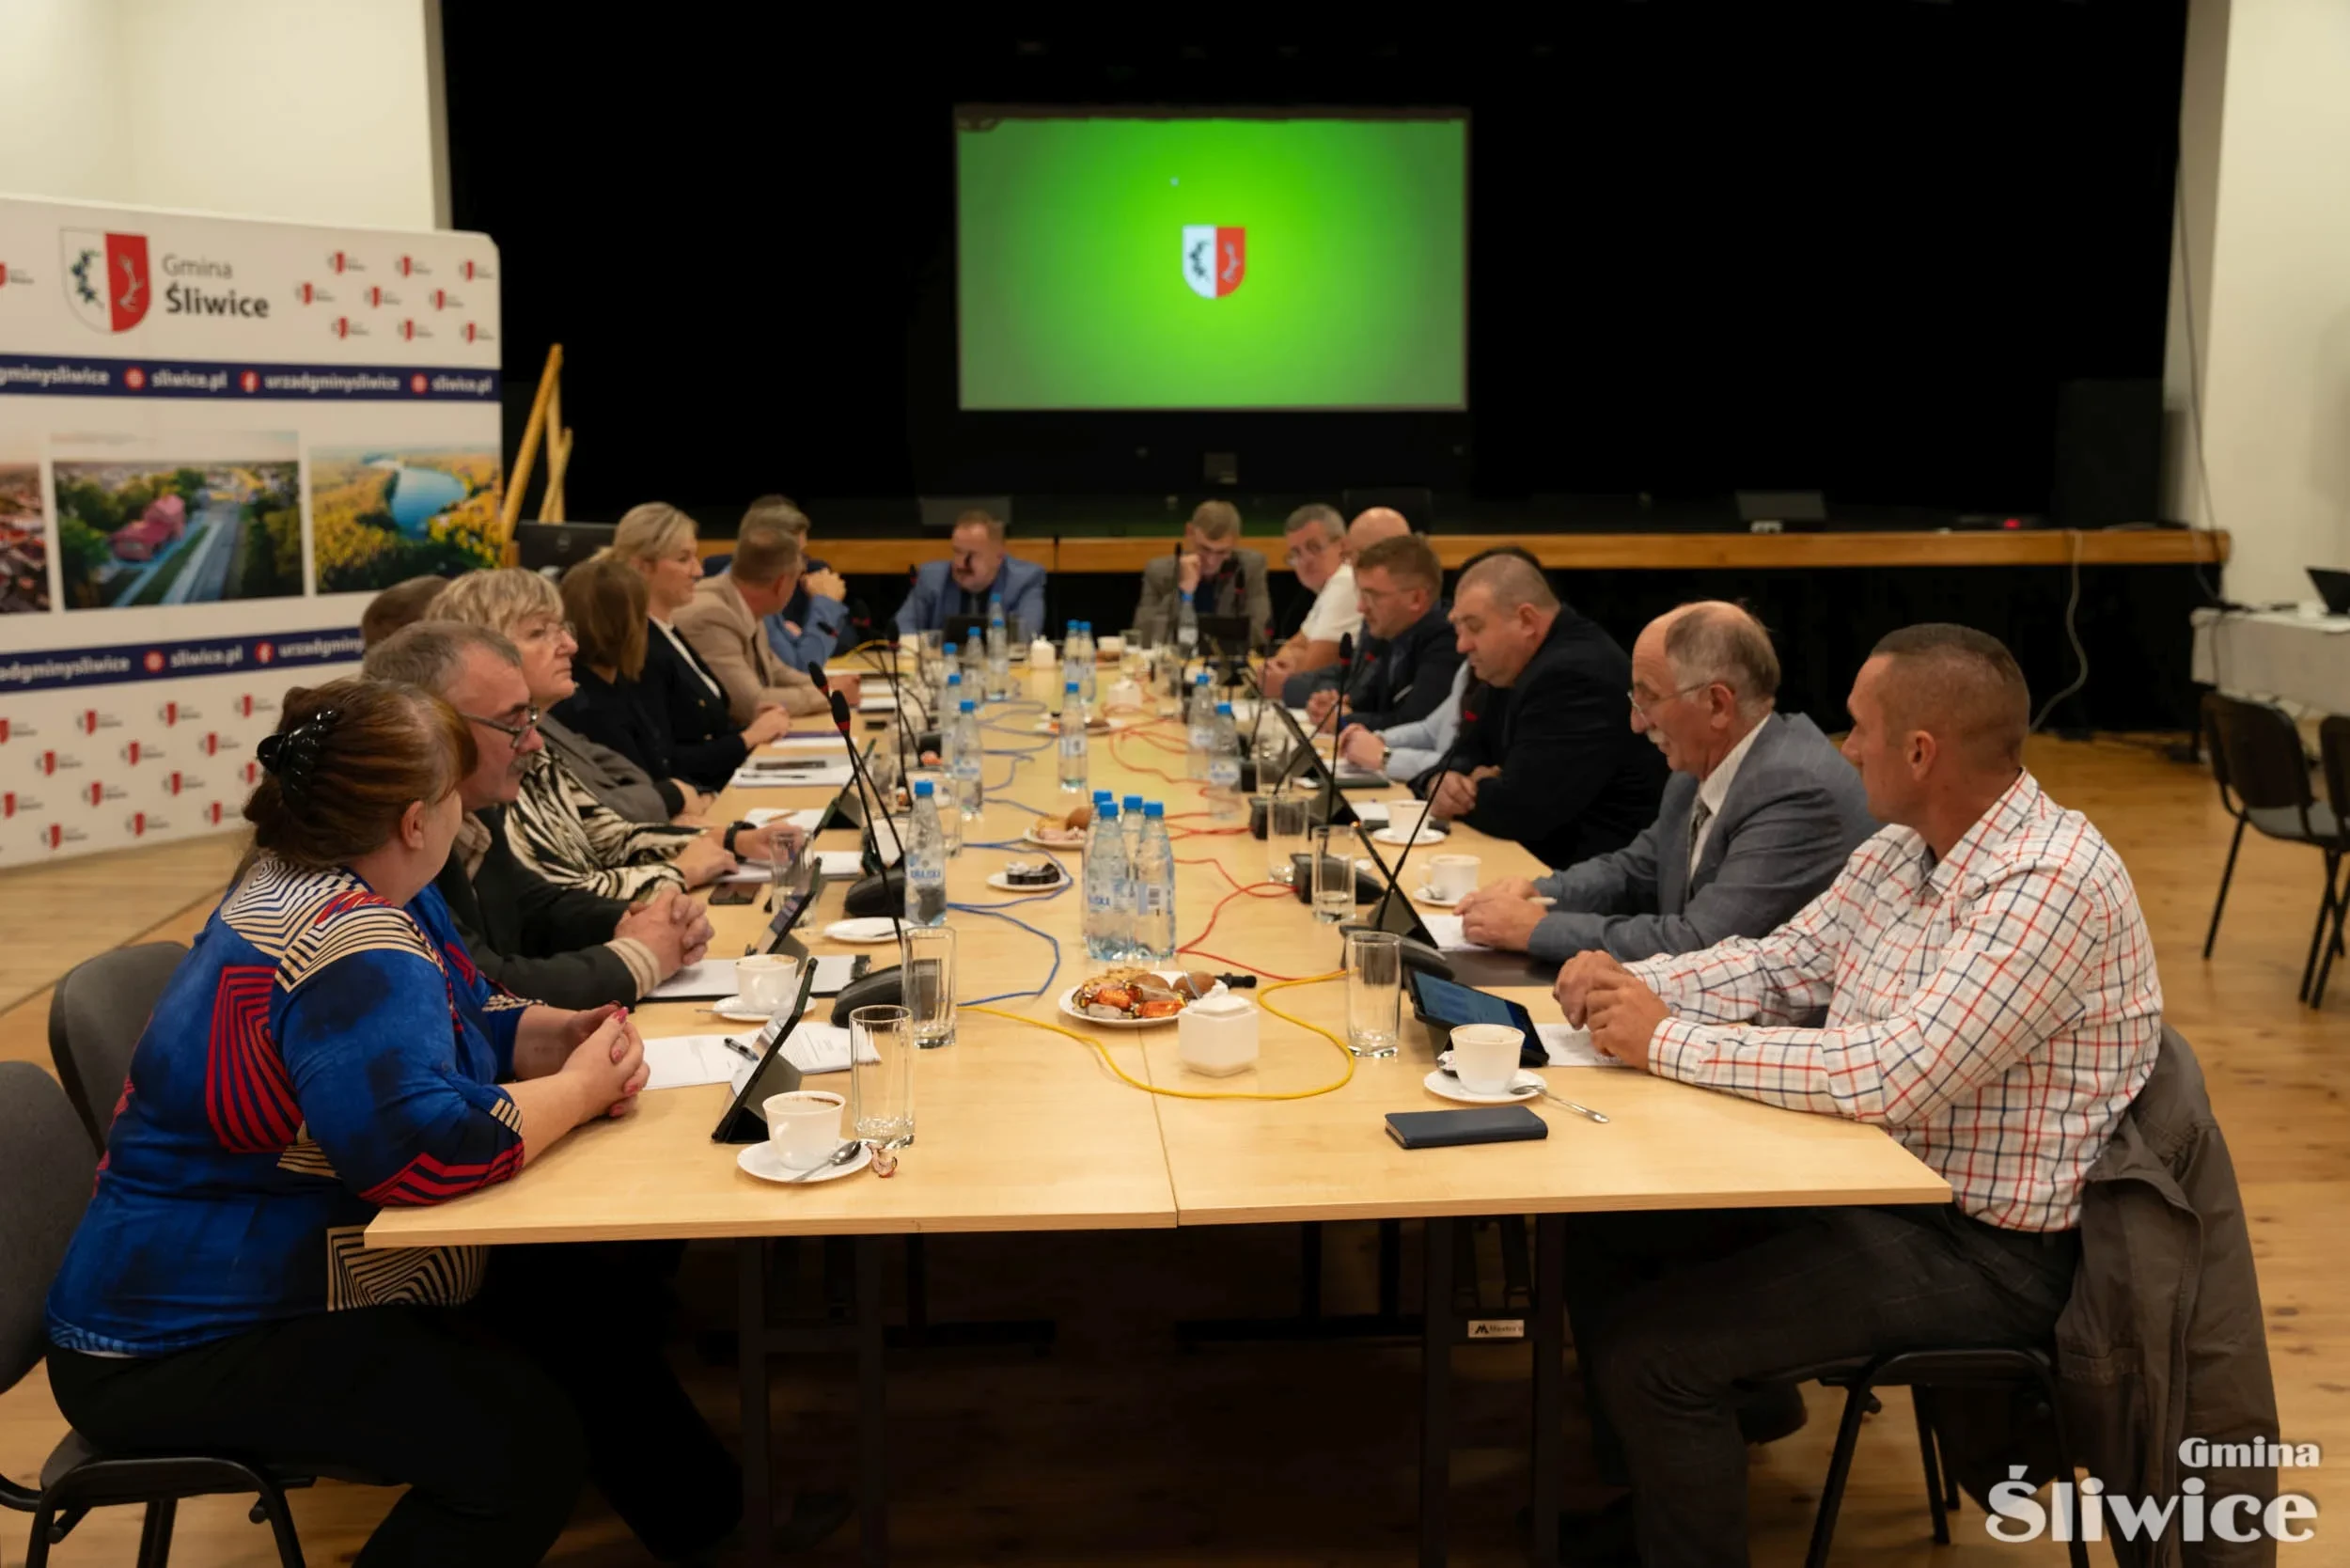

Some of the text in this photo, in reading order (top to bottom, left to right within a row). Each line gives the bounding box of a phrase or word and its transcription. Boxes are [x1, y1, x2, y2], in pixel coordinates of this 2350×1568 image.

[161, 253, 234, 280] Gmina
[164, 280, 270, 319] Śliwice
[150, 368, 227, 392] sliwice.pl
[431, 373, 494, 397] sliwice.pl
[169, 645, 244, 667] sliwice.pl
